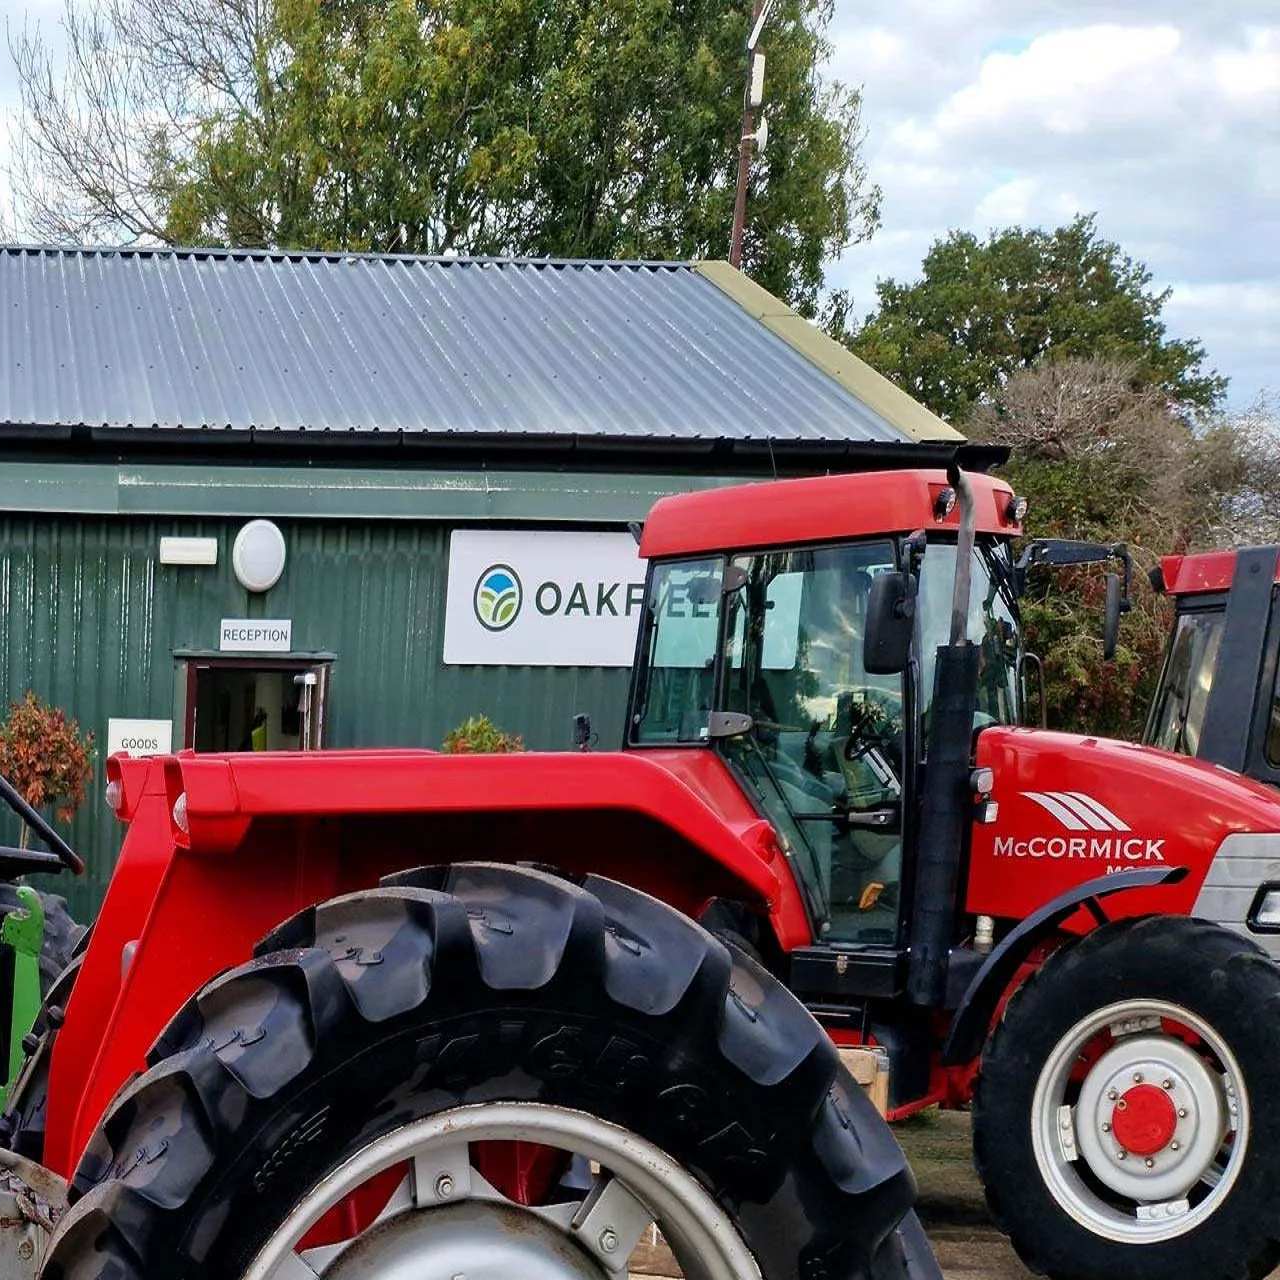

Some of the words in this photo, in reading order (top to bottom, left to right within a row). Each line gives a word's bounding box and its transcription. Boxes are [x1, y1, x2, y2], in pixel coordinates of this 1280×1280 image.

[223, 628, 288, 641] RECEPTION
[121, 738, 158, 749] GOODS
[993, 836, 1166, 860] McCORMICK
